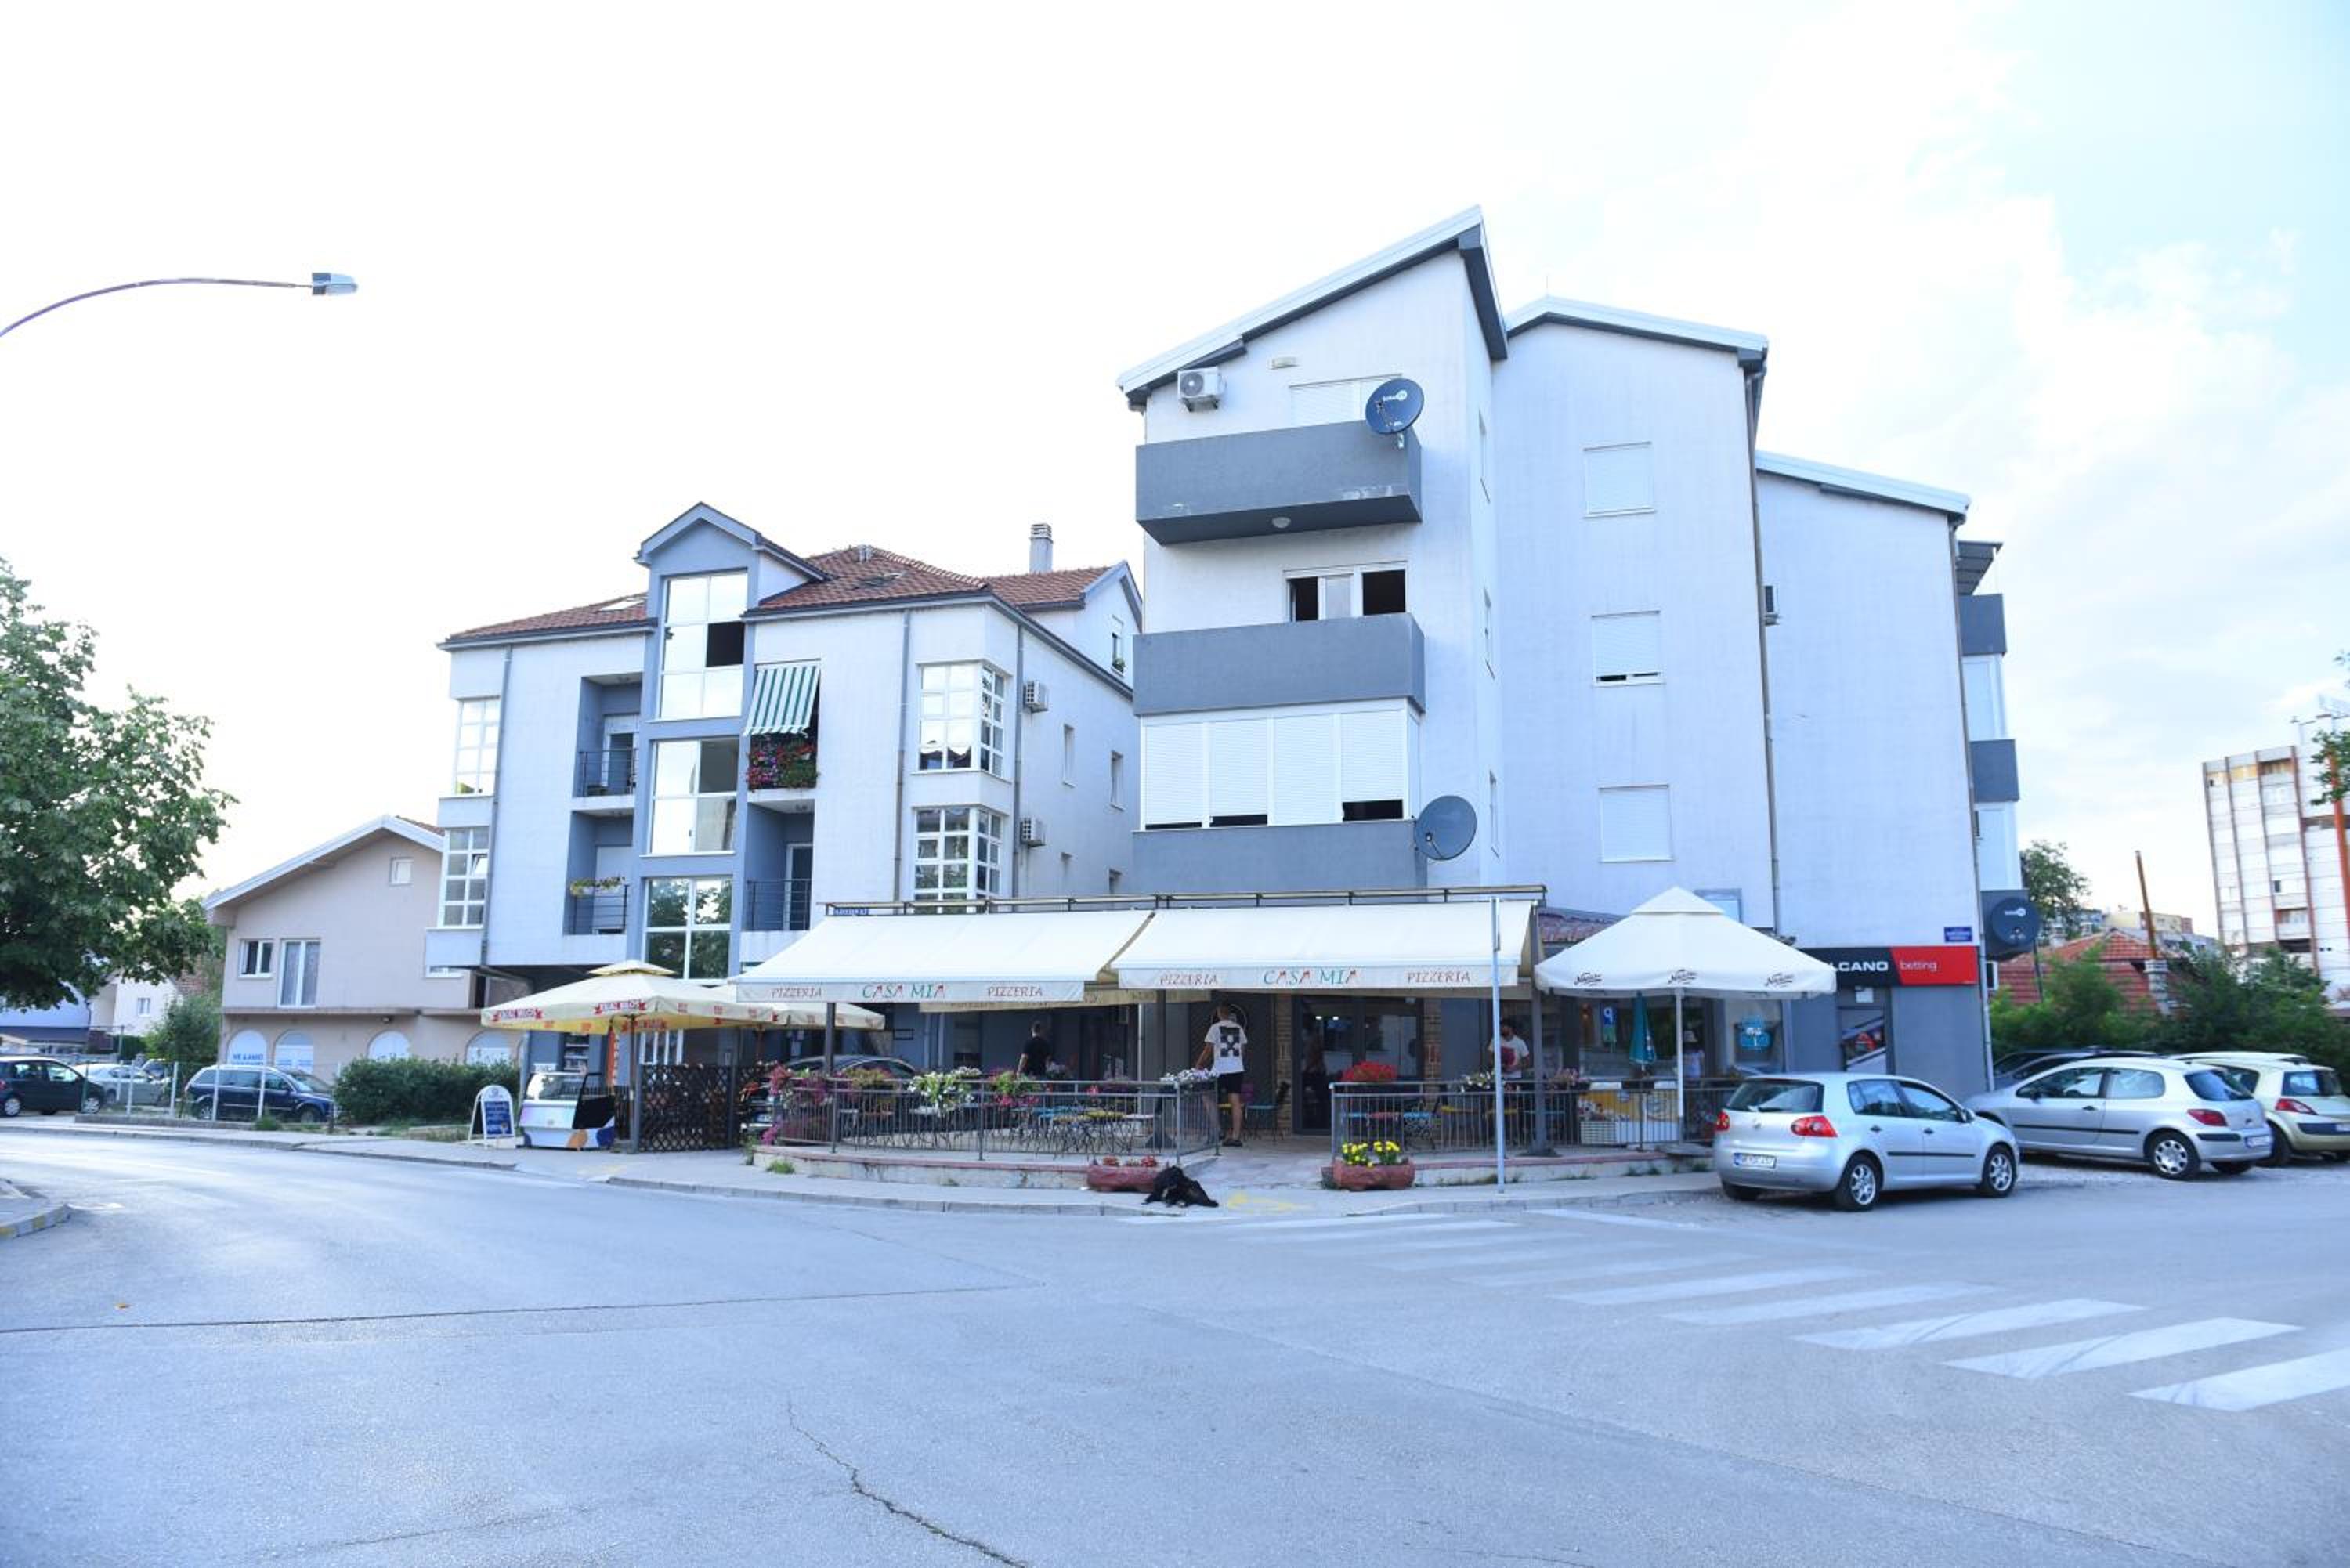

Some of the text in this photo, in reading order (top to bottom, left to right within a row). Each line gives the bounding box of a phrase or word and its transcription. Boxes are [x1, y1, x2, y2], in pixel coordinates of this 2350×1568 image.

[1159, 973, 1218, 985] PIZZERIA
[1263, 968, 1359, 985] CASA MIA
[1406, 970, 1471, 984] PIZZERIA
[772, 987, 822, 999] PIZZERIA
[862, 983, 946, 999] CASA MIA
[987, 986, 1043, 999] PIZZERIA
